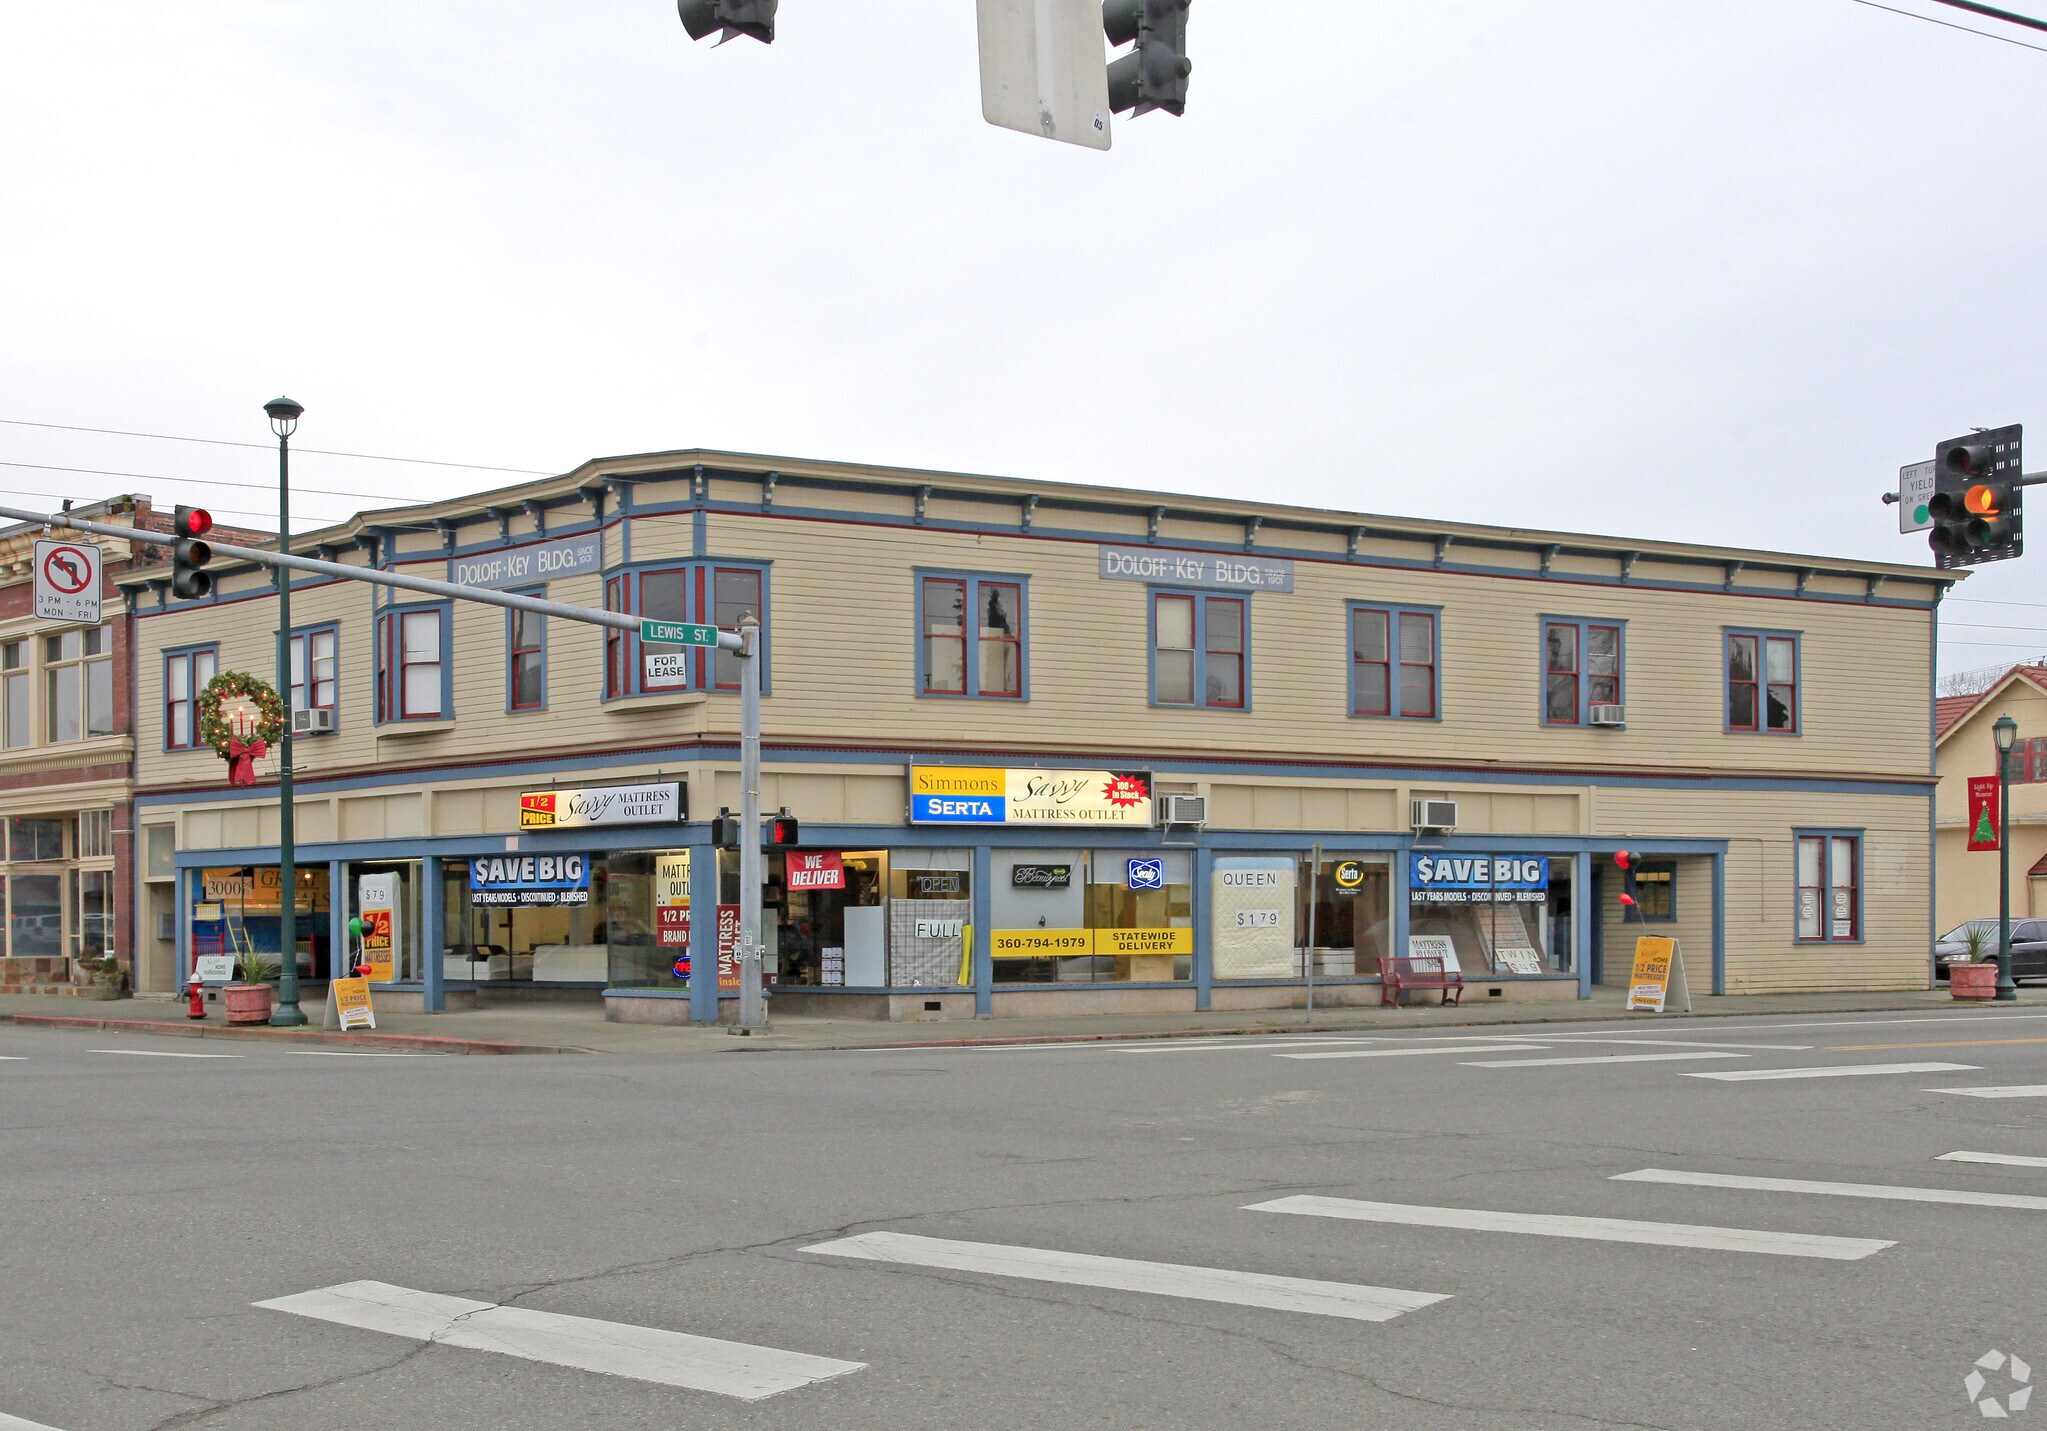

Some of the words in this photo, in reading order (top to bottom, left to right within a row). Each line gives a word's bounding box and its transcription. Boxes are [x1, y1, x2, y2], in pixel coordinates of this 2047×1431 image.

[1903, 470, 1917, 480] LEFT
[1910, 478, 1934, 491] YIELD
[1905, 496, 1914, 505] ON
[577, 546, 594, 557] SINCE
[538, 549, 577, 572] BLDG.
[1216, 561, 1265, 585] BLDG.
[38, 595, 44, 603] 3
[48, 596, 61, 604] PM
[84, 600, 98, 608] PM
[44, 607, 64, 617] MON
[78, 610, 92, 619] FRI
[650, 624, 684, 640] LEWIS
[654, 656, 677, 666] FOR
[648, 667, 684, 677] LEASE
[919, 774, 999, 791] Simmons
[1013, 776, 1089, 804] Savvy
[1120, 790, 1140, 800] Stock
[529, 795, 549, 808] 1/2
[618, 790, 670, 804] MATTRESS
[559, 793, 617, 821] Savvy
[623, 804, 664, 816] OUTLET
[928, 798, 993, 816] SERTA
[523, 811, 553, 825] PRICE
[1013, 808, 1076, 820] MATTRESS
[1078, 809, 1126, 821] OUTLET
[539, 856, 582, 880] BIG
[804, 855, 823, 869] WE
[1134, 867, 1156, 881] Sealy
[1341, 868, 1358, 880] Serta
[1495, 859, 1540, 882] BIG
[792, 870, 839, 886] DELIVER
[923, 878, 958, 891] OPEN
[1223, 873, 1276, 886] QUEEN
[208, 881, 240, 896] 3000
[1411, 892, 1425, 901] LAST
[1426, 892, 1443, 901] YEARS
[1444, 892, 1467, 901] MODELS
[662, 910, 677, 922] 1/2
[663, 930, 687, 943] BRAND
[917, 923, 959, 937] FULL
[1112, 931, 1176, 941] STATEWIDE
[718, 910, 735, 975] MATTRESS
[997, 937, 1085, 949] 360-794-1979
[1118, 941, 1173, 951] DELIVERY
[1411, 940, 1447, 949] MATTRESS
[1498, 950, 1537, 960] TWIN
[1647, 964, 1667, 973] PRICE
[1634, 972, 1665, 981] MATTRESSES
